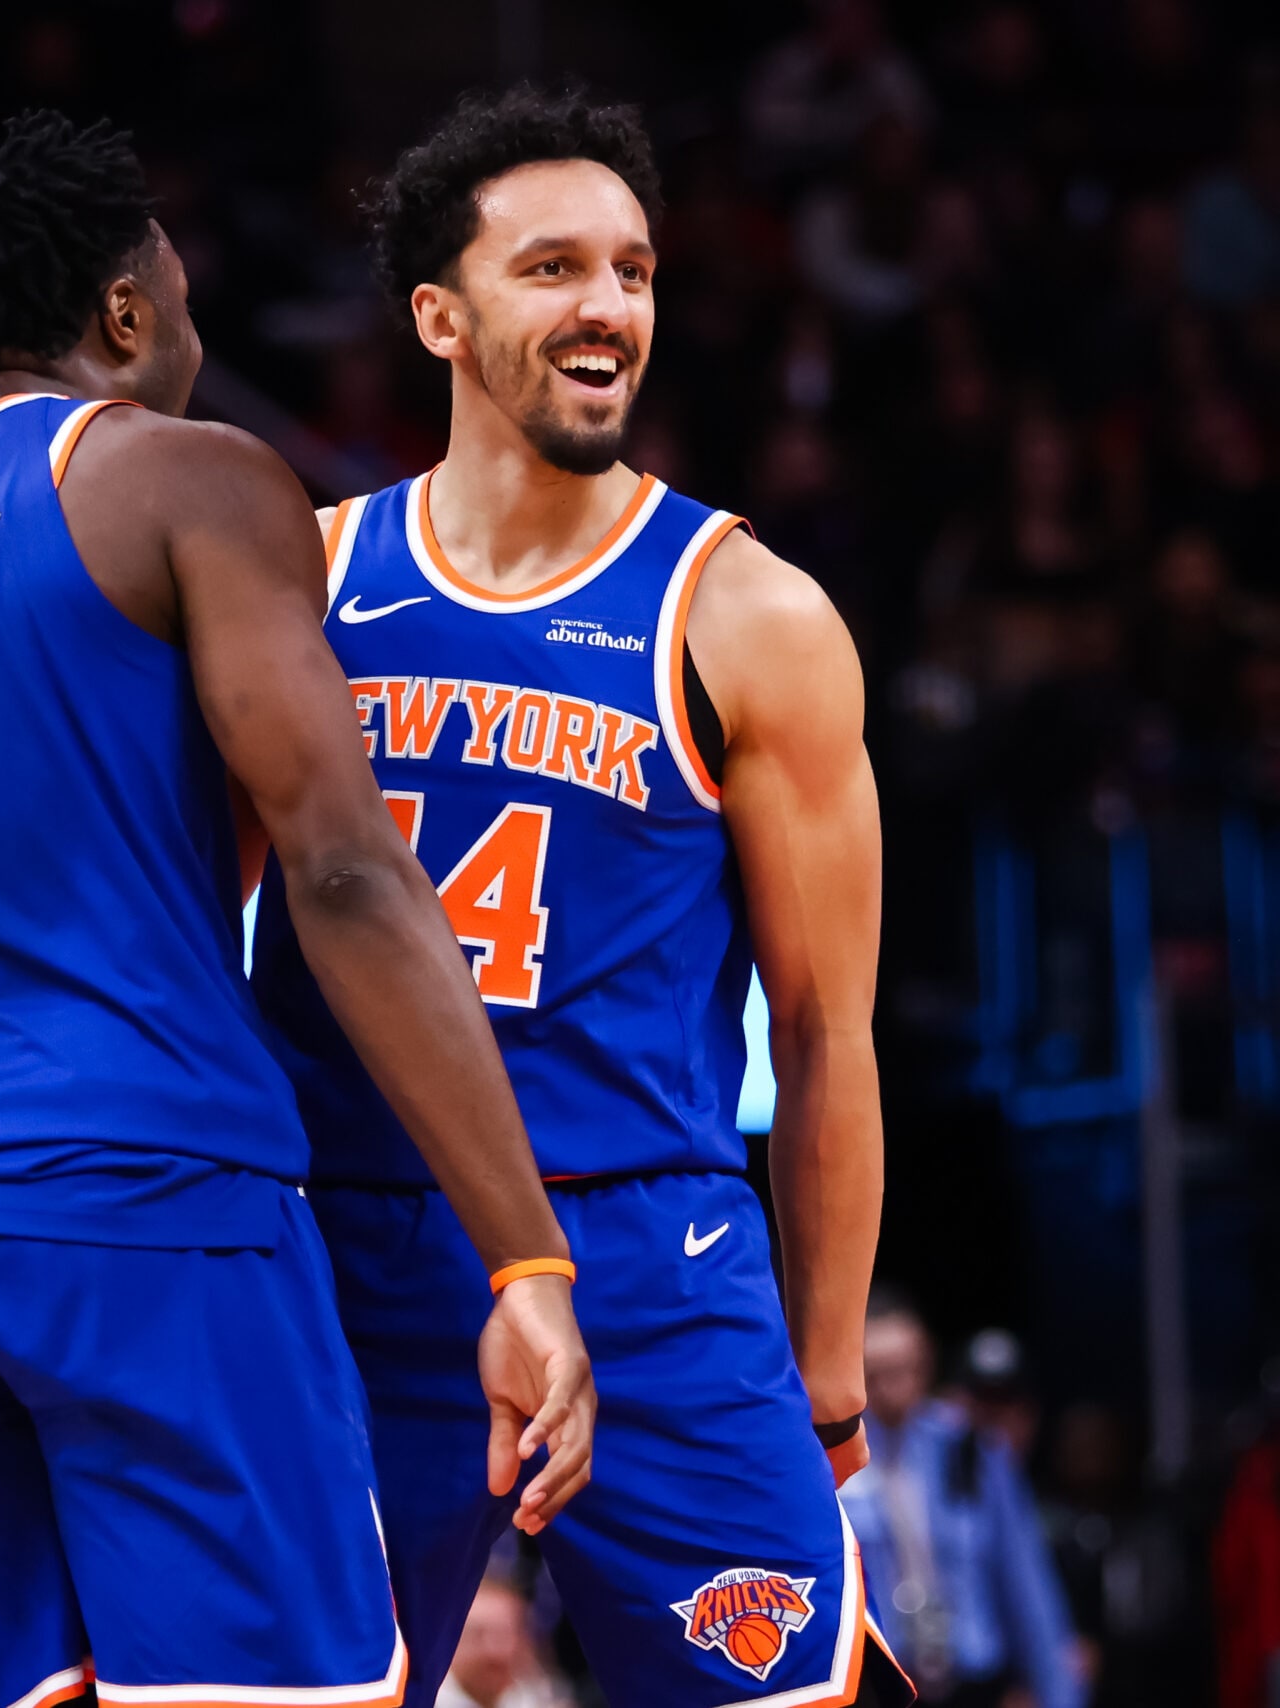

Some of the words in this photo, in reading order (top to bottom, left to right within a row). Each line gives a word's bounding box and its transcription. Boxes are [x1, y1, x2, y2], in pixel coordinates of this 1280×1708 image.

[551, 618, 603, 630] experience
[545, 627, 585, 644] abu
[587, 631, 647, 652] dhabi
[348, 675, 464, 760] EW
[460, 679, 659, 812] YORK
[716, 1572, 737, 1588] NEW
[738, 1570, 766, 1581] YORK
[689, 1575, 810, 1638] KNICKS
